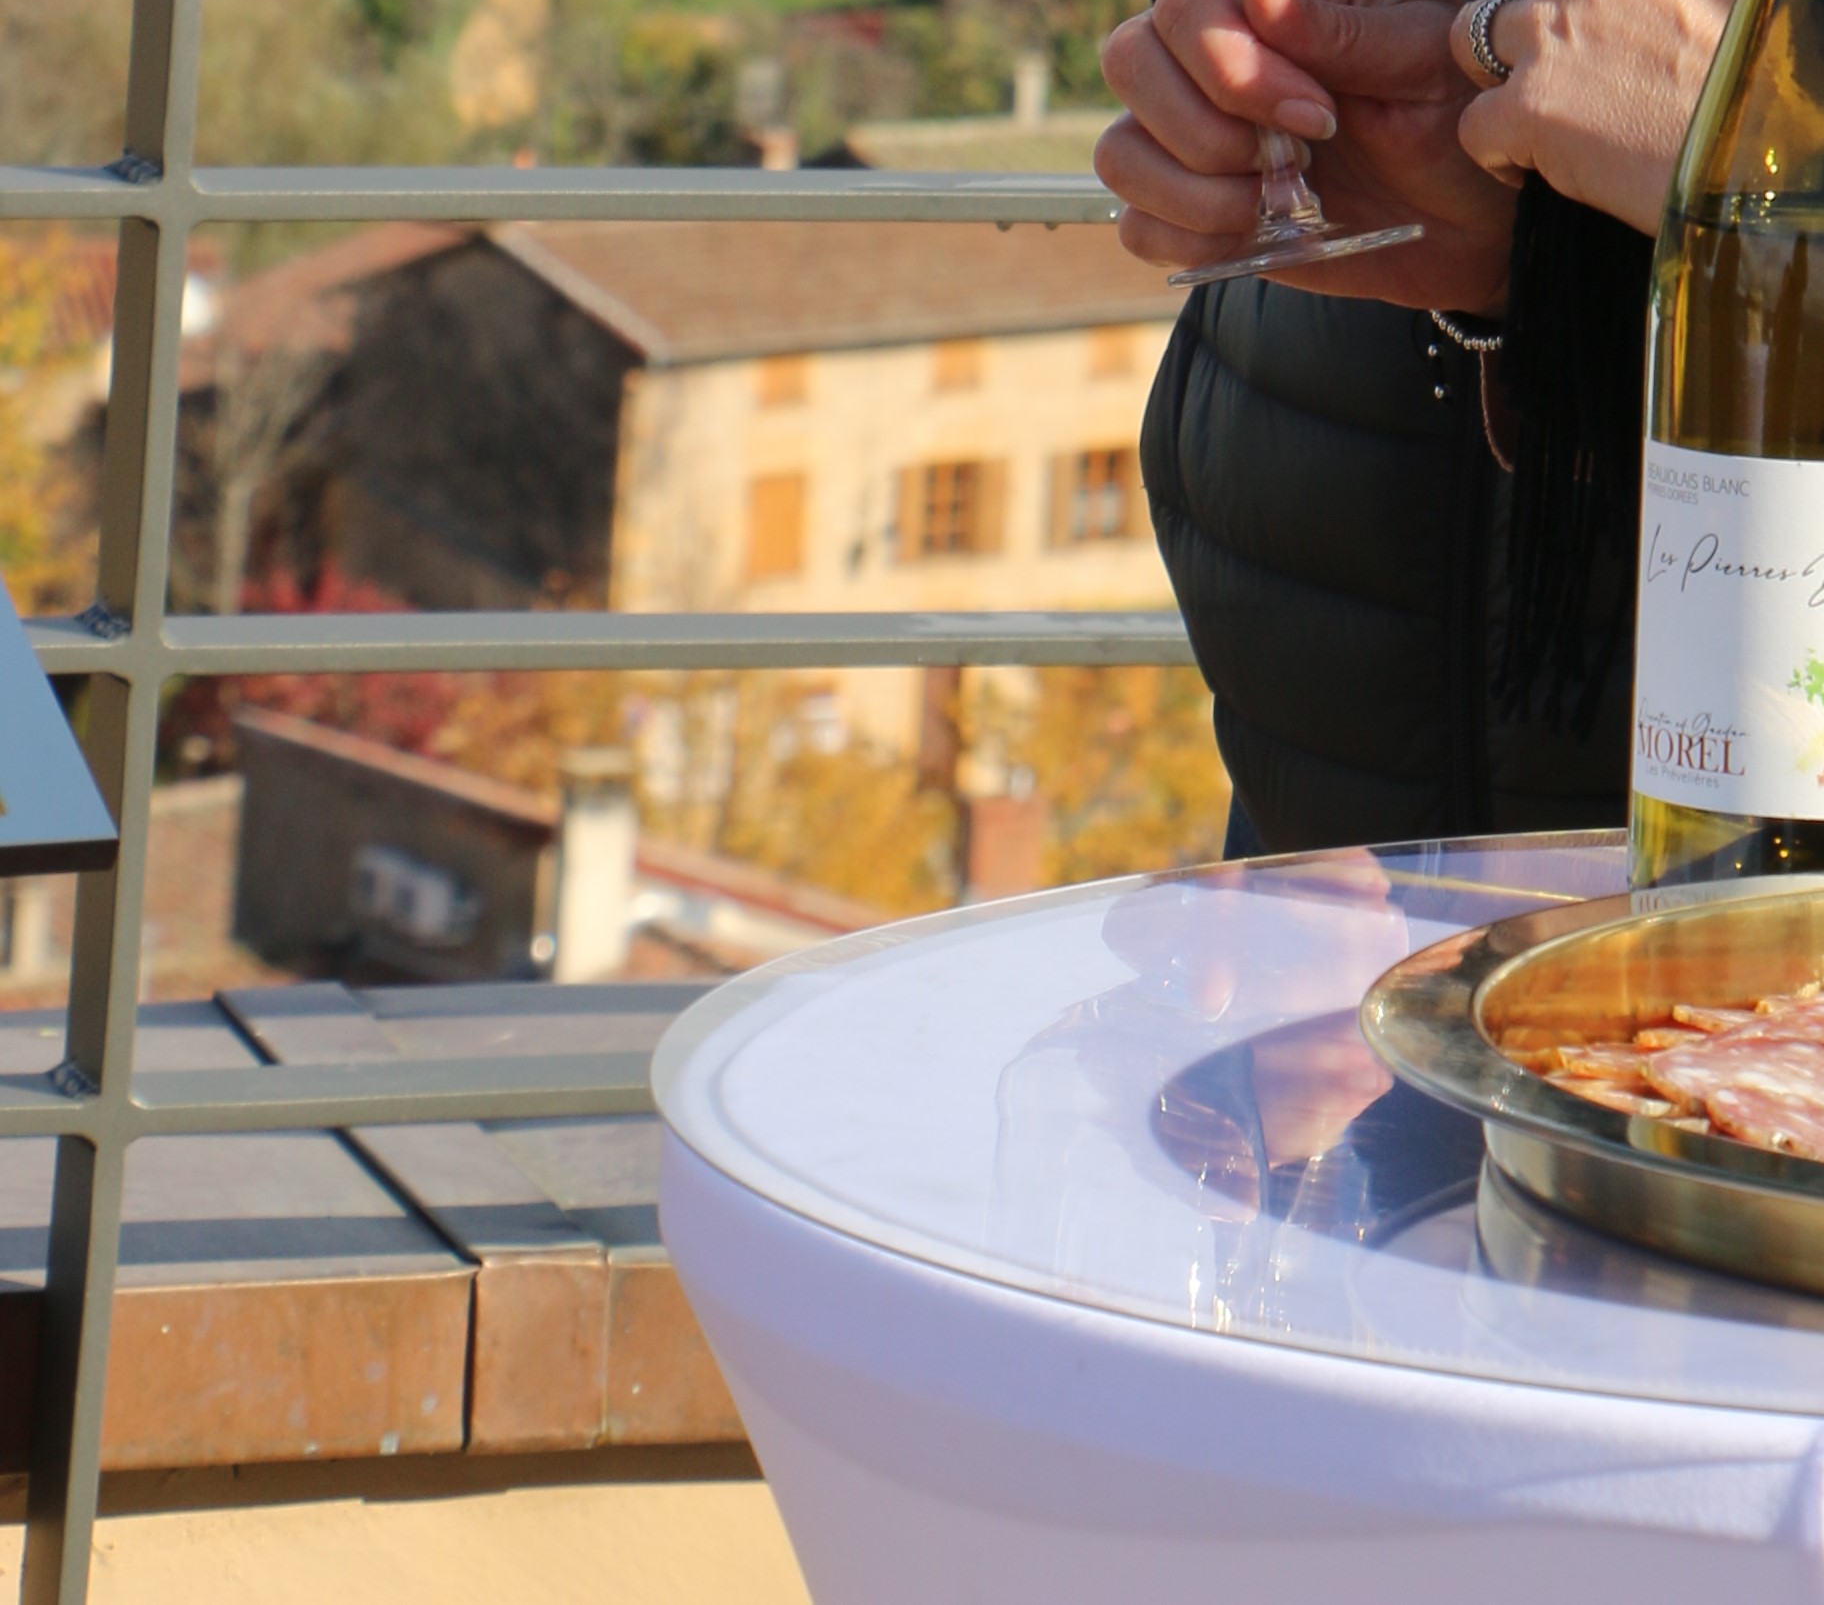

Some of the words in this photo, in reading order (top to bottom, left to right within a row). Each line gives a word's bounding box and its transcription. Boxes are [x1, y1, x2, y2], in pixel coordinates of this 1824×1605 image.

[1702, 474, 1751, 498] BLANC
[1647, 523, 1679, 583] Les
[1680, 532, 1796, 593] Pierres
[1637, 721, 1747, 777] MOREL
